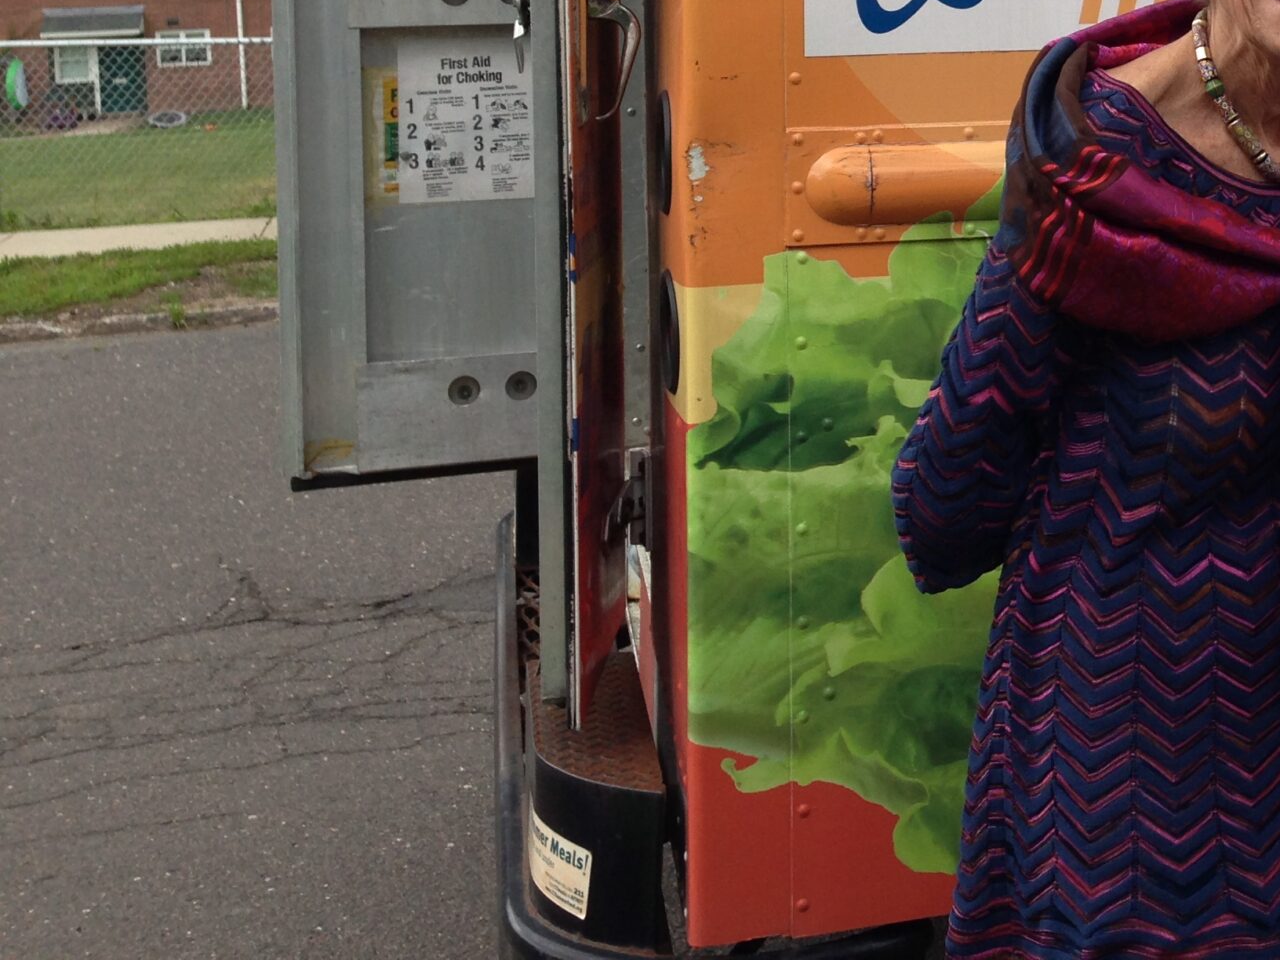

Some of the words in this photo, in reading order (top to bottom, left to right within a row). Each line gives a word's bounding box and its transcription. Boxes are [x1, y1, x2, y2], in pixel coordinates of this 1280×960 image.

[440, 57, 468, 70] First
[471, 55, 491, 68] Aid
[437, 72, 453, 85] for
[456, 70, 503, 84] Choking
[405, 98, 414, 114] 1
[471, 93, 480, 110] 1
[472, 114, 483, 131] 2
[407, 123, 418, 140] 2
[473, 135, 485, 152] 3
[408, 153, 420, 170] 3
[474, 155, 486, 171] 4
[550, 837, 589, 876] Meals!
